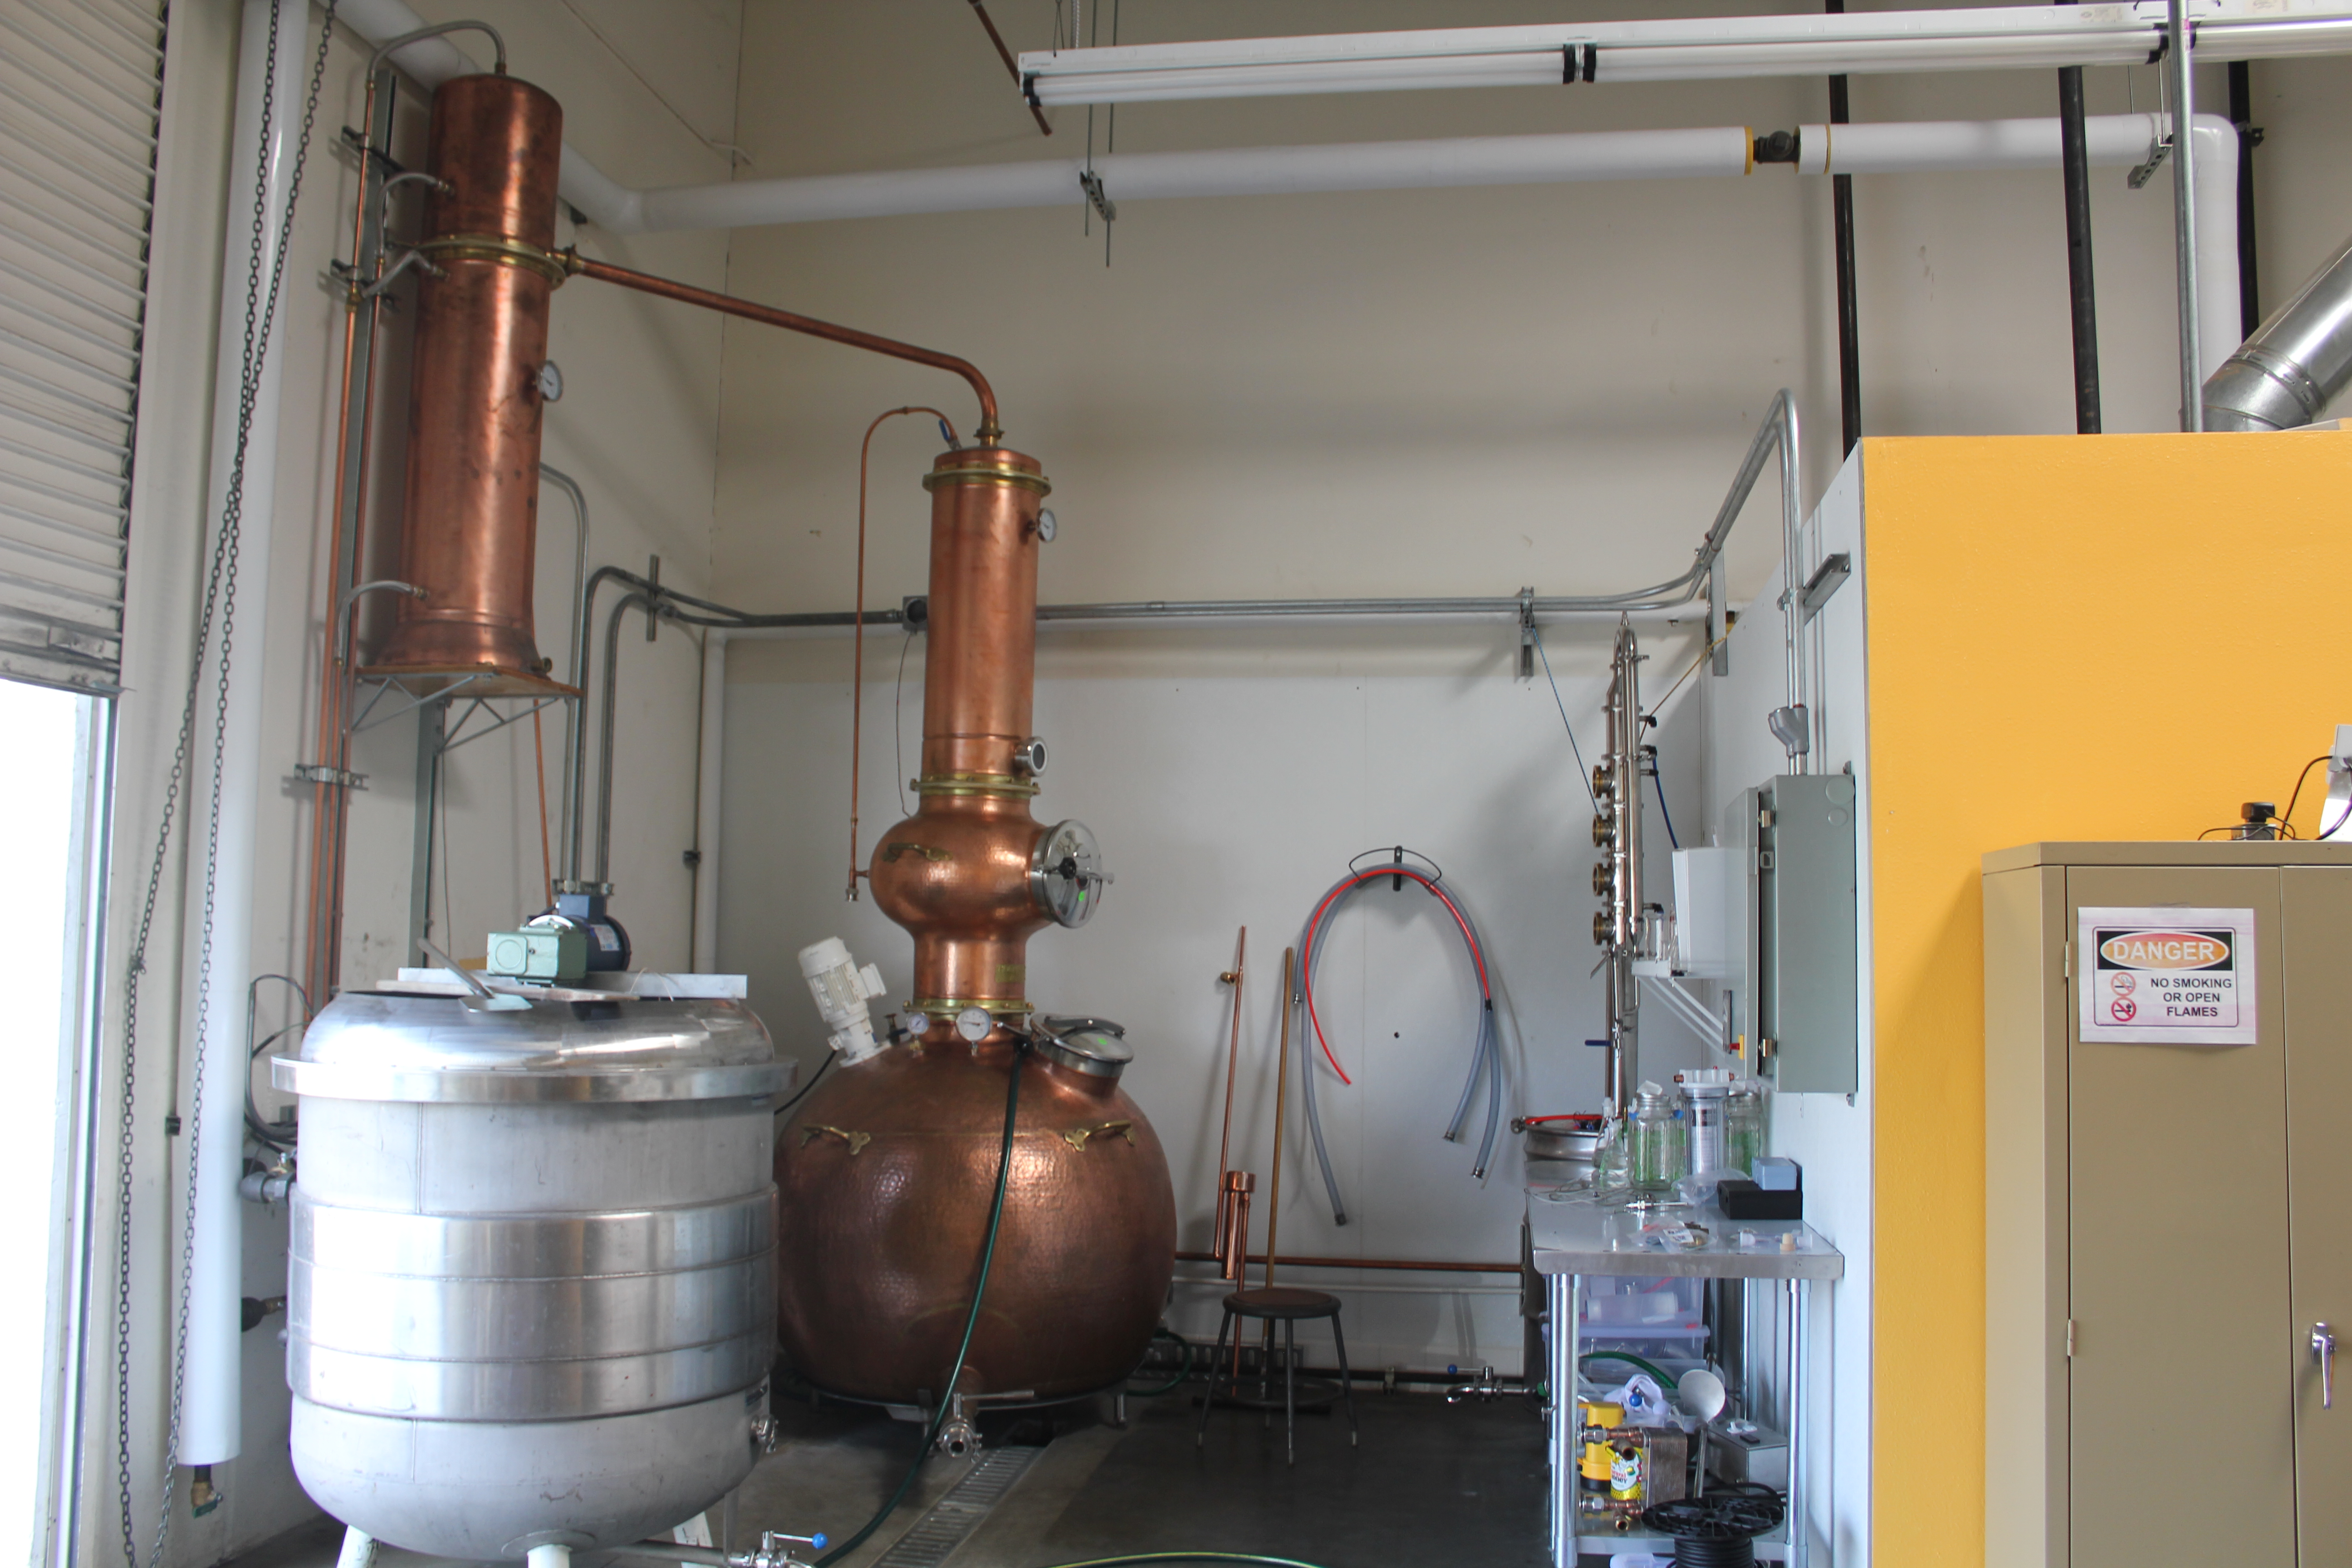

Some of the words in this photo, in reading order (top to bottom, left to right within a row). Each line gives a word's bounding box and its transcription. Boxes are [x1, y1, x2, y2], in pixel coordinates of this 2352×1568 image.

[2113, 941, 2215, 960] DANGER
[2151, 978, 2169, 988] NO
[2173, 978, 2231, 988] SMOKING
[2163, 992, 2181, 1002] OR
[2185, 992, 2220, 1002] OPEN
[2167, 1006, 2218, 1016] FLAMES
